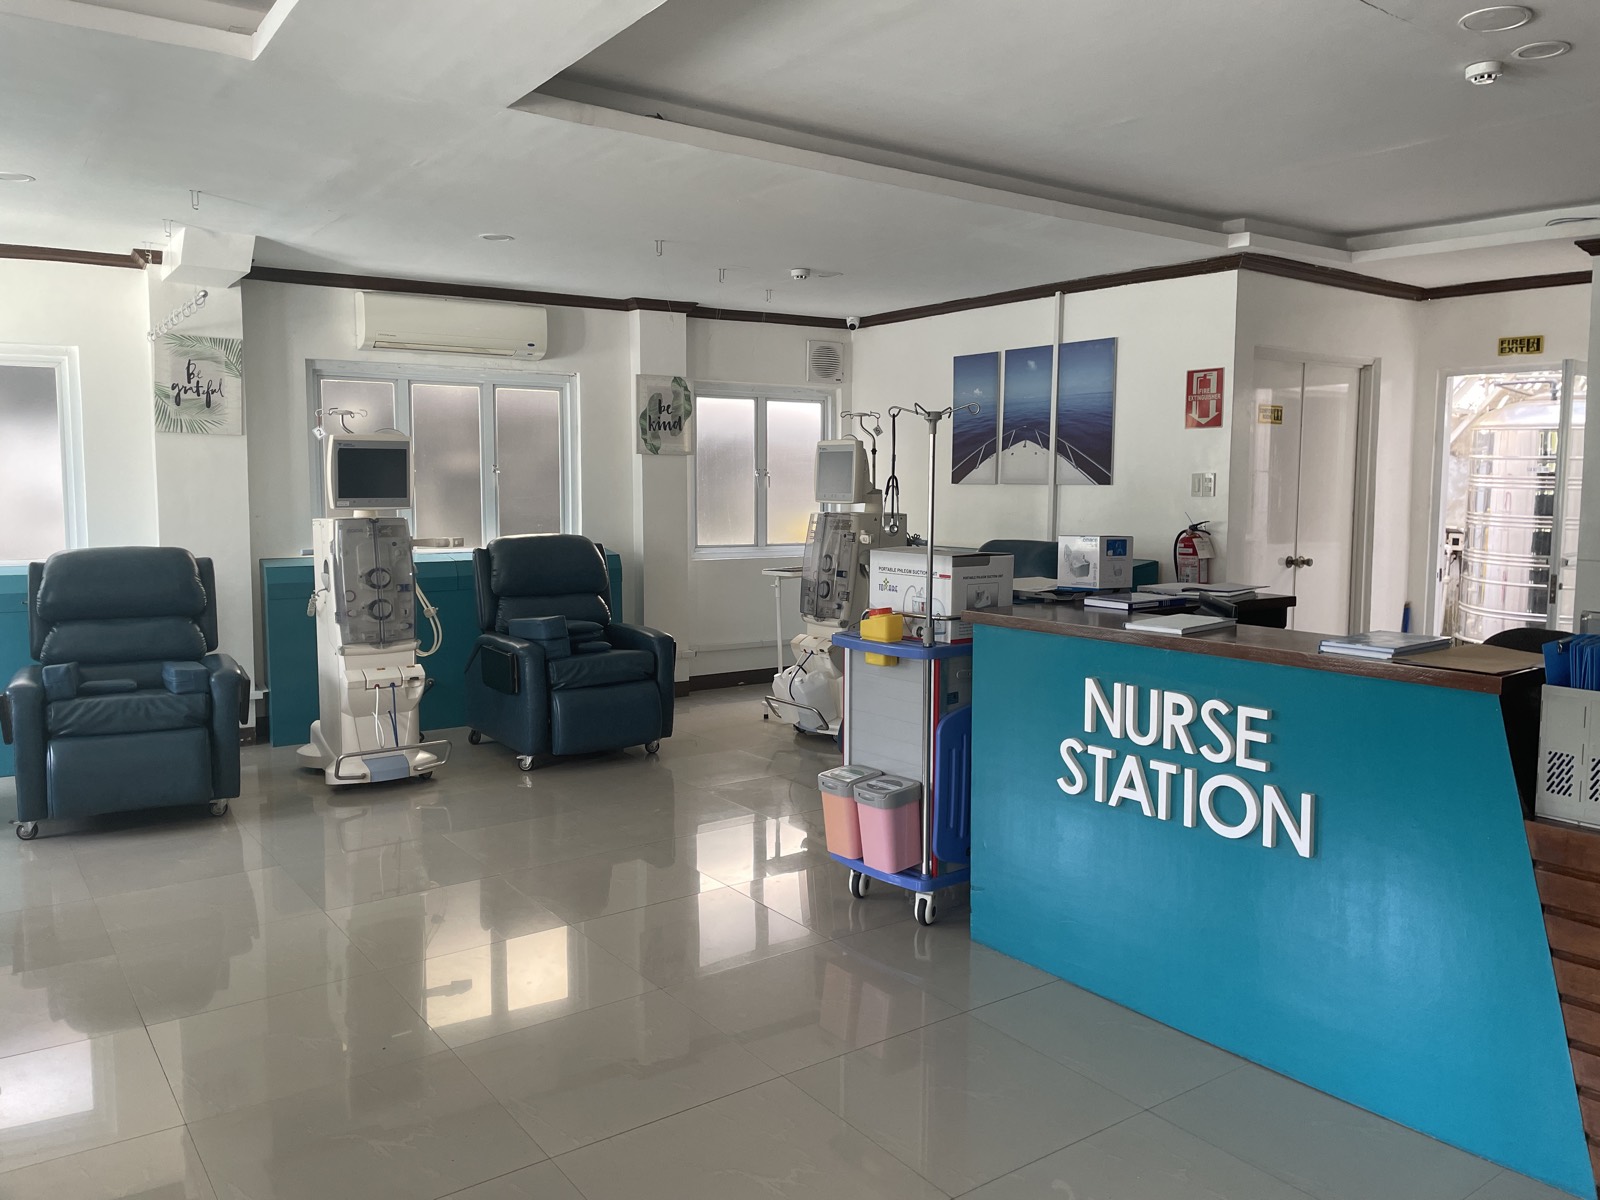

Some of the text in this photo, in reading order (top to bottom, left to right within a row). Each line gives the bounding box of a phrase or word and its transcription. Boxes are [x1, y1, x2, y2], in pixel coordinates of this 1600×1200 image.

[186, 359, 203, 384] Be
[171, 378, 224, 408] grateful
[658, 399, 673, 414] be
[648, 415, 682, 431] kind
[1083, 677, 1273, 773] NURSE
[1056, 737, 1316, 859] STATION
